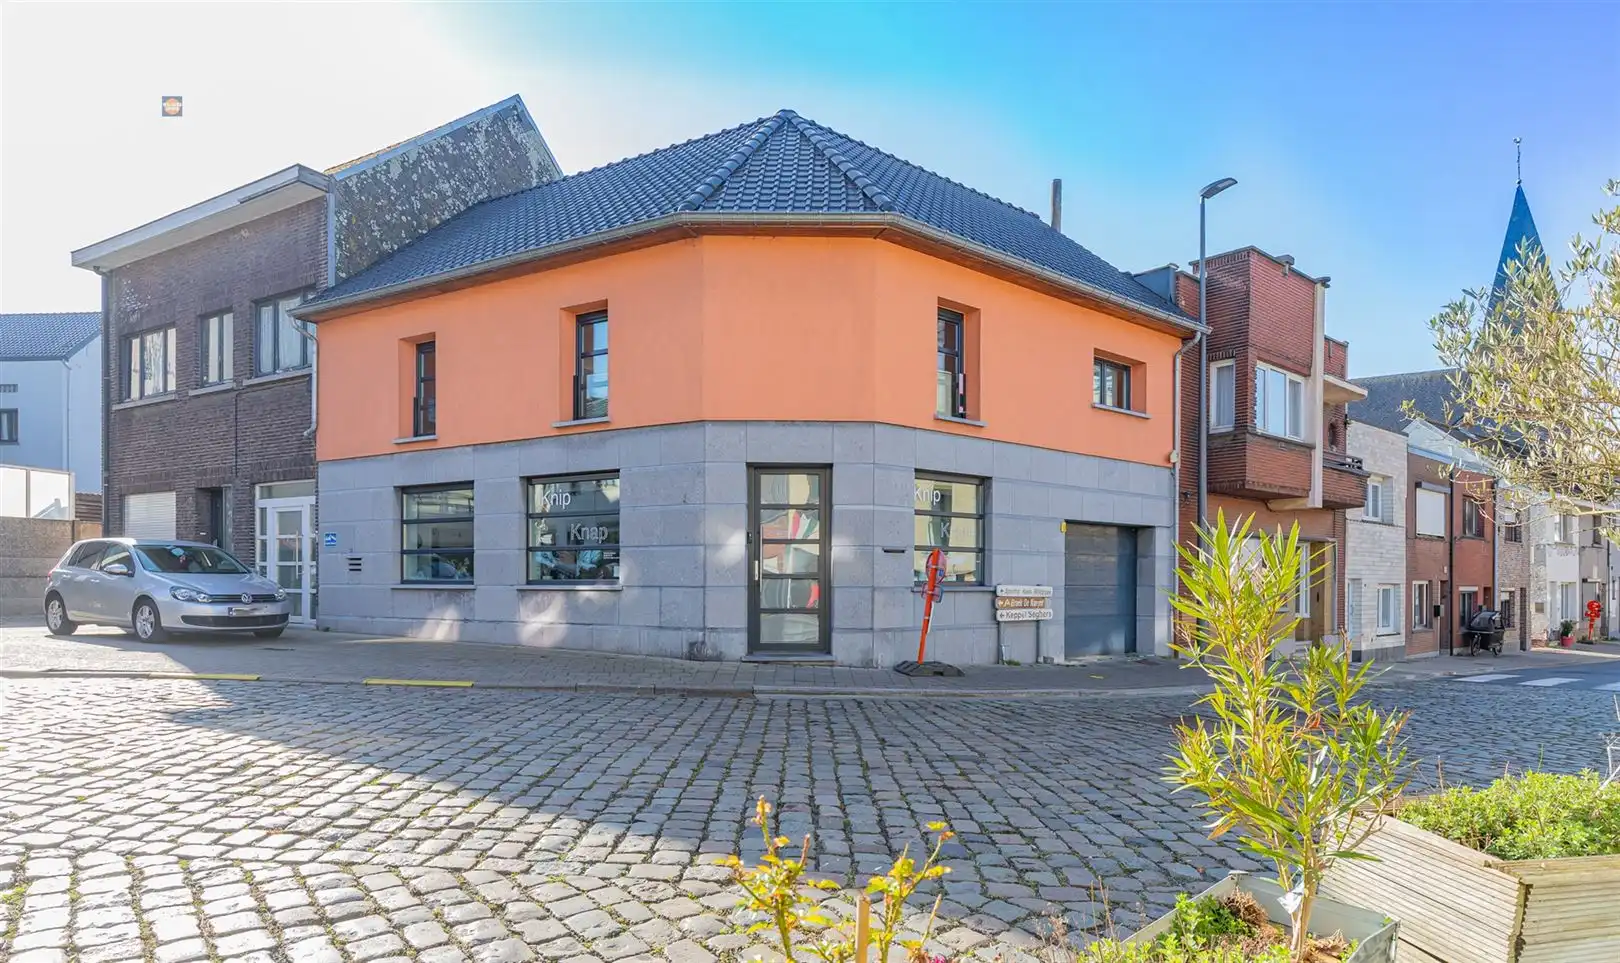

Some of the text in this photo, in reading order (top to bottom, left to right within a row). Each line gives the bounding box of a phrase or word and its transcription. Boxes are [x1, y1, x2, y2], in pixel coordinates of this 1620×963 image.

[542, 489, 571, 509] Knip
[914, 486, 941, 506] Knip
[570, 523, 608, 544] Knap
